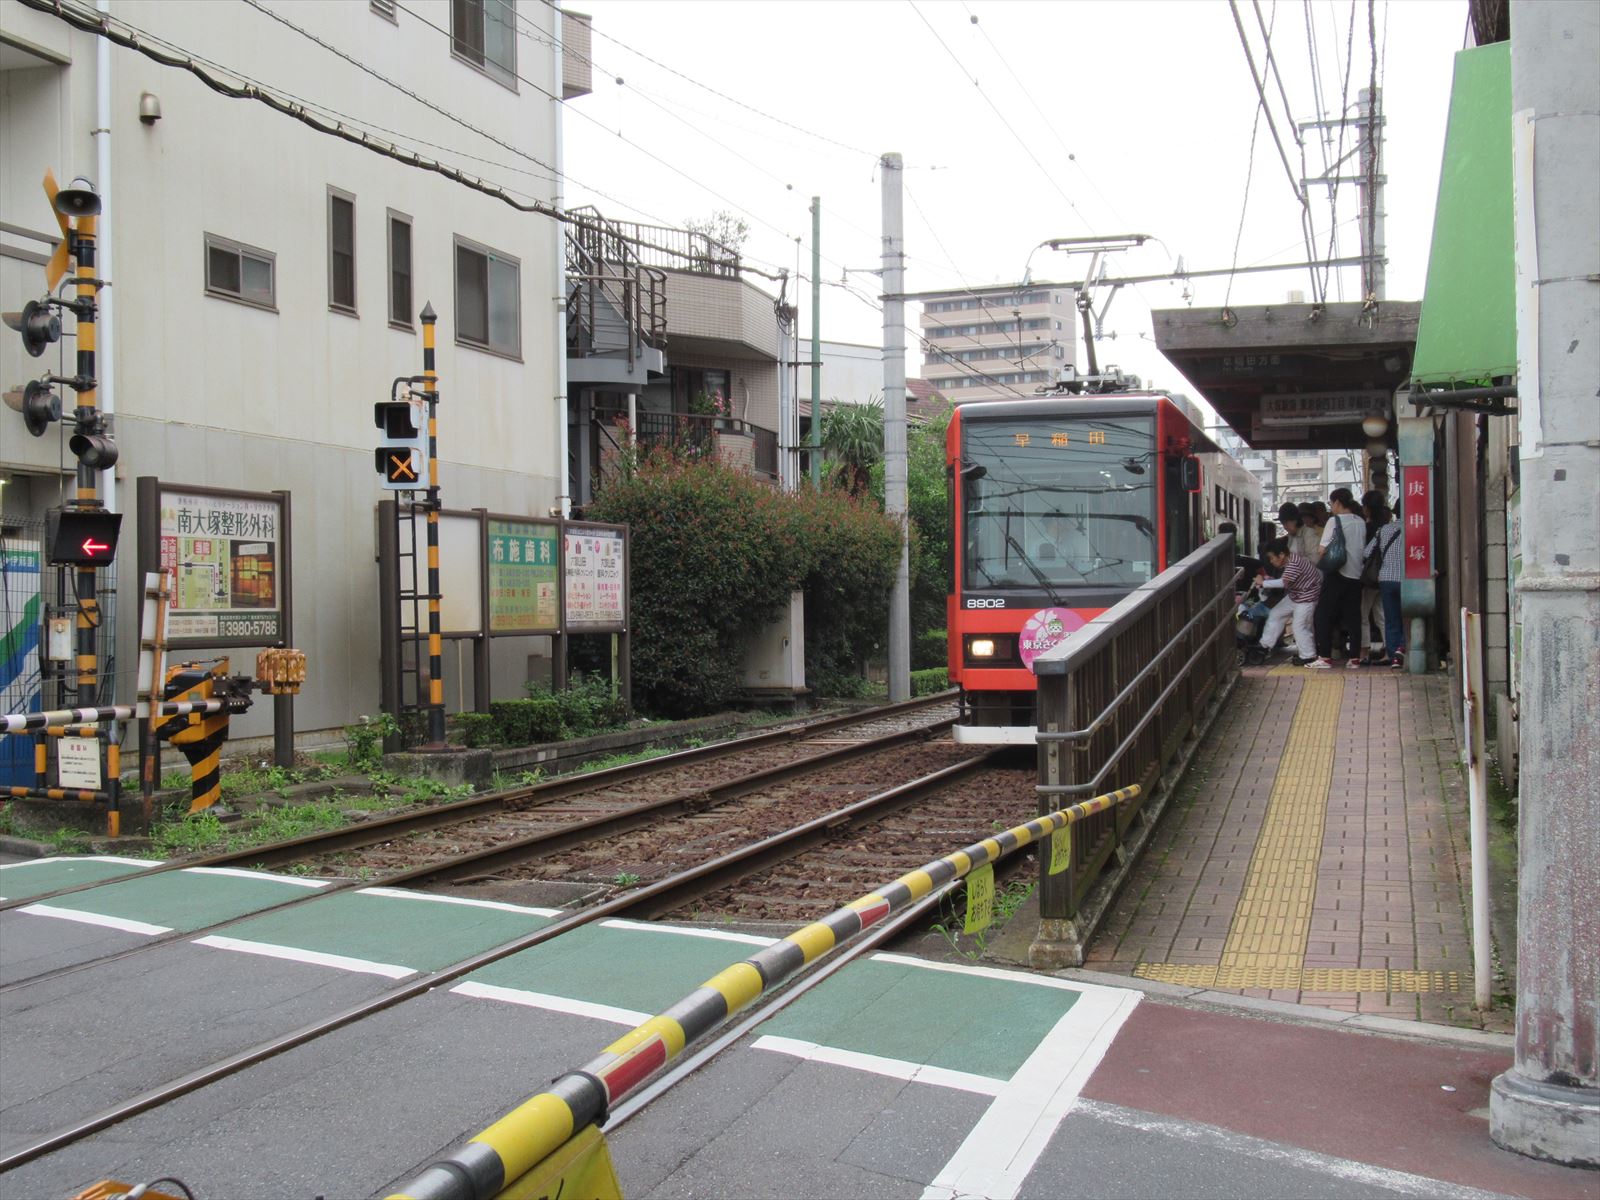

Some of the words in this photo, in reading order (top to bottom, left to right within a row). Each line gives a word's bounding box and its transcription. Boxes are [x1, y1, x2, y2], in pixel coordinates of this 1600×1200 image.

[1012, 431, 1105, 448] 早稲田
[177, 507, 275, 538] 南大塚整形外科
[1408, 481, 1425, 560] 庚申塚
[493, 537, 550, 563] 布施歯科
[967, 599, 1005, 608] 8902
[1023, 639, 1060, 650] 東京さく
